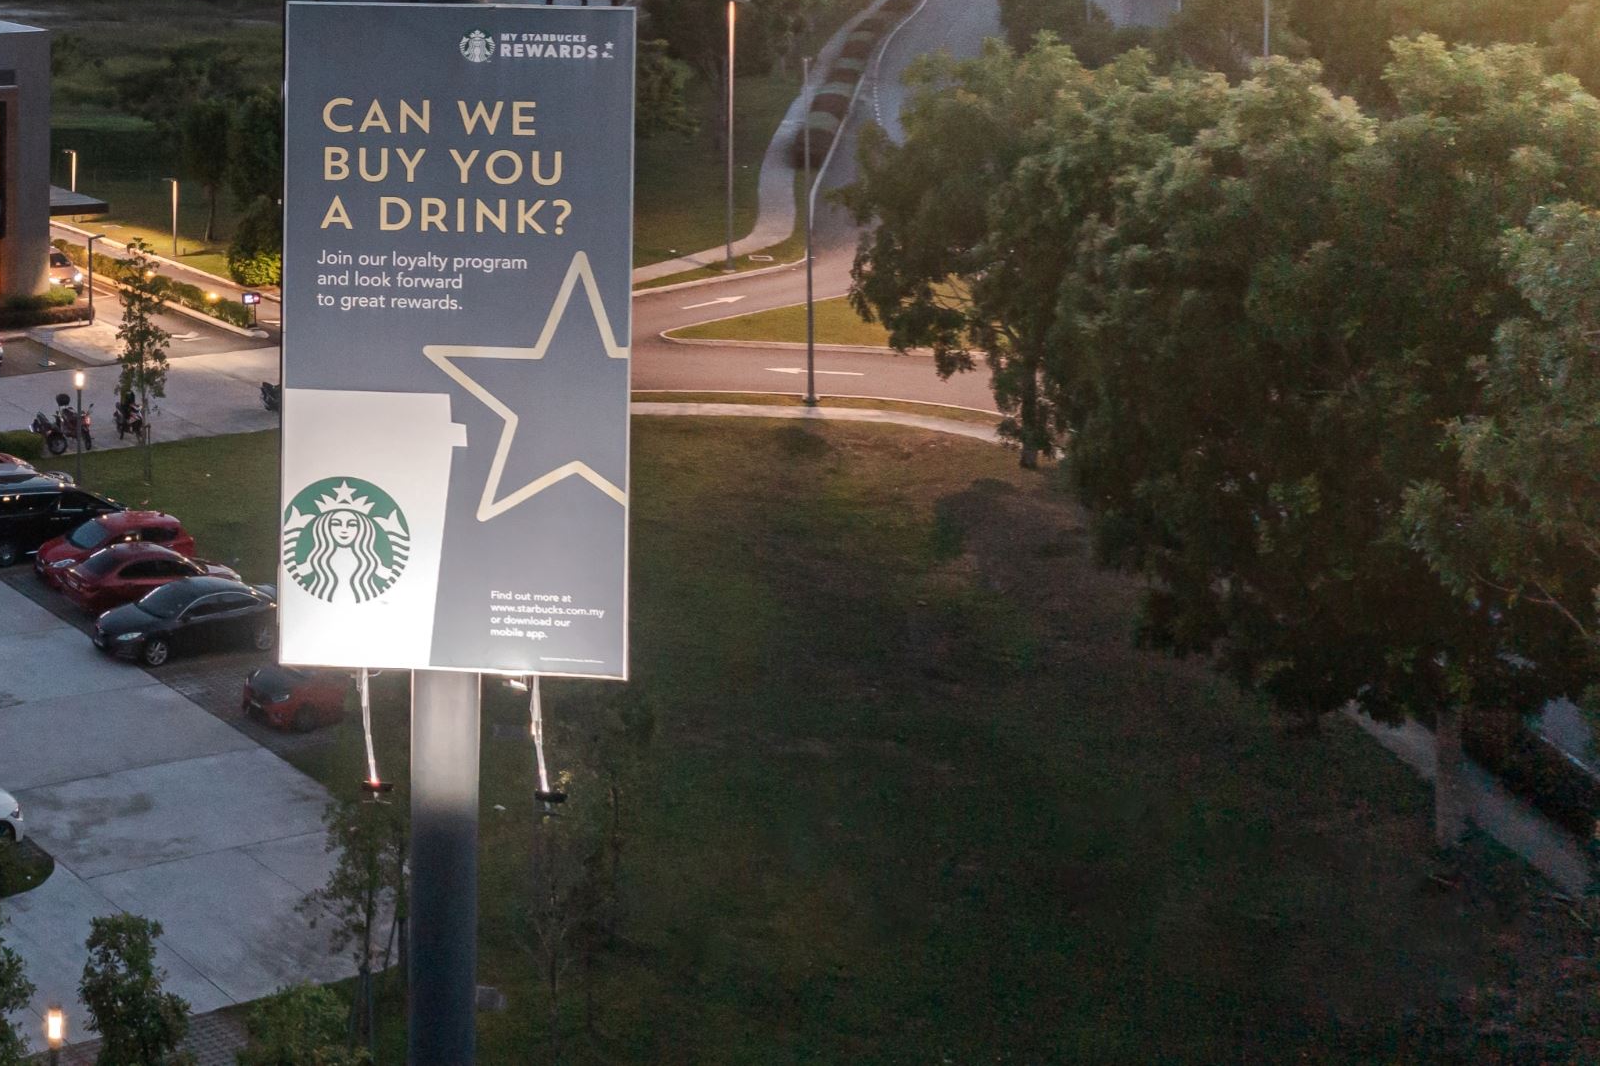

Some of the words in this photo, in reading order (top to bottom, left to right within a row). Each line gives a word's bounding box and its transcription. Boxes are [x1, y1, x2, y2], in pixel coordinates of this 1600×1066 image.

[522, 34, 586, 42] STARBUCKS
[500, 44, 597, 58] REWARDS
[322, 97, 430, 133] CAN
[457, 100, 537, 136] WE
[324, 147, 426, 182] BUY
[449, 149, 562, 185] YOU
[320, 195, 353, 230] A
[379, 197, 573, 235] DRINK?
[318, 250, 352, 265] Join
[359, 254, 387, 265] our
[392, 252, 448, 271] loyalty
[453, 256, 527, 273] program
[318, 271, 349, 286] and
[355, 271, 391, 287] look
[396, 273, 462, 289] forward
[318, 294, 334, 306] to
[340, 295, 385, 311] great
[391, 295, 463, 310] rewards.
[491, 590, 512, 600] Find
[515, 592, 531, 601] out
[534, 594, 560, 602] more
[562, 594, 572, 603] at
[490, 603, 605, 619] www.starbucks.com.my
[490, 616, 501, 624] or
[504, 614, 551, 626] download
[554, 618, 571, 627] our
[490, 627, 524, 637] mobile
[526, 630, 548, 640] app.
